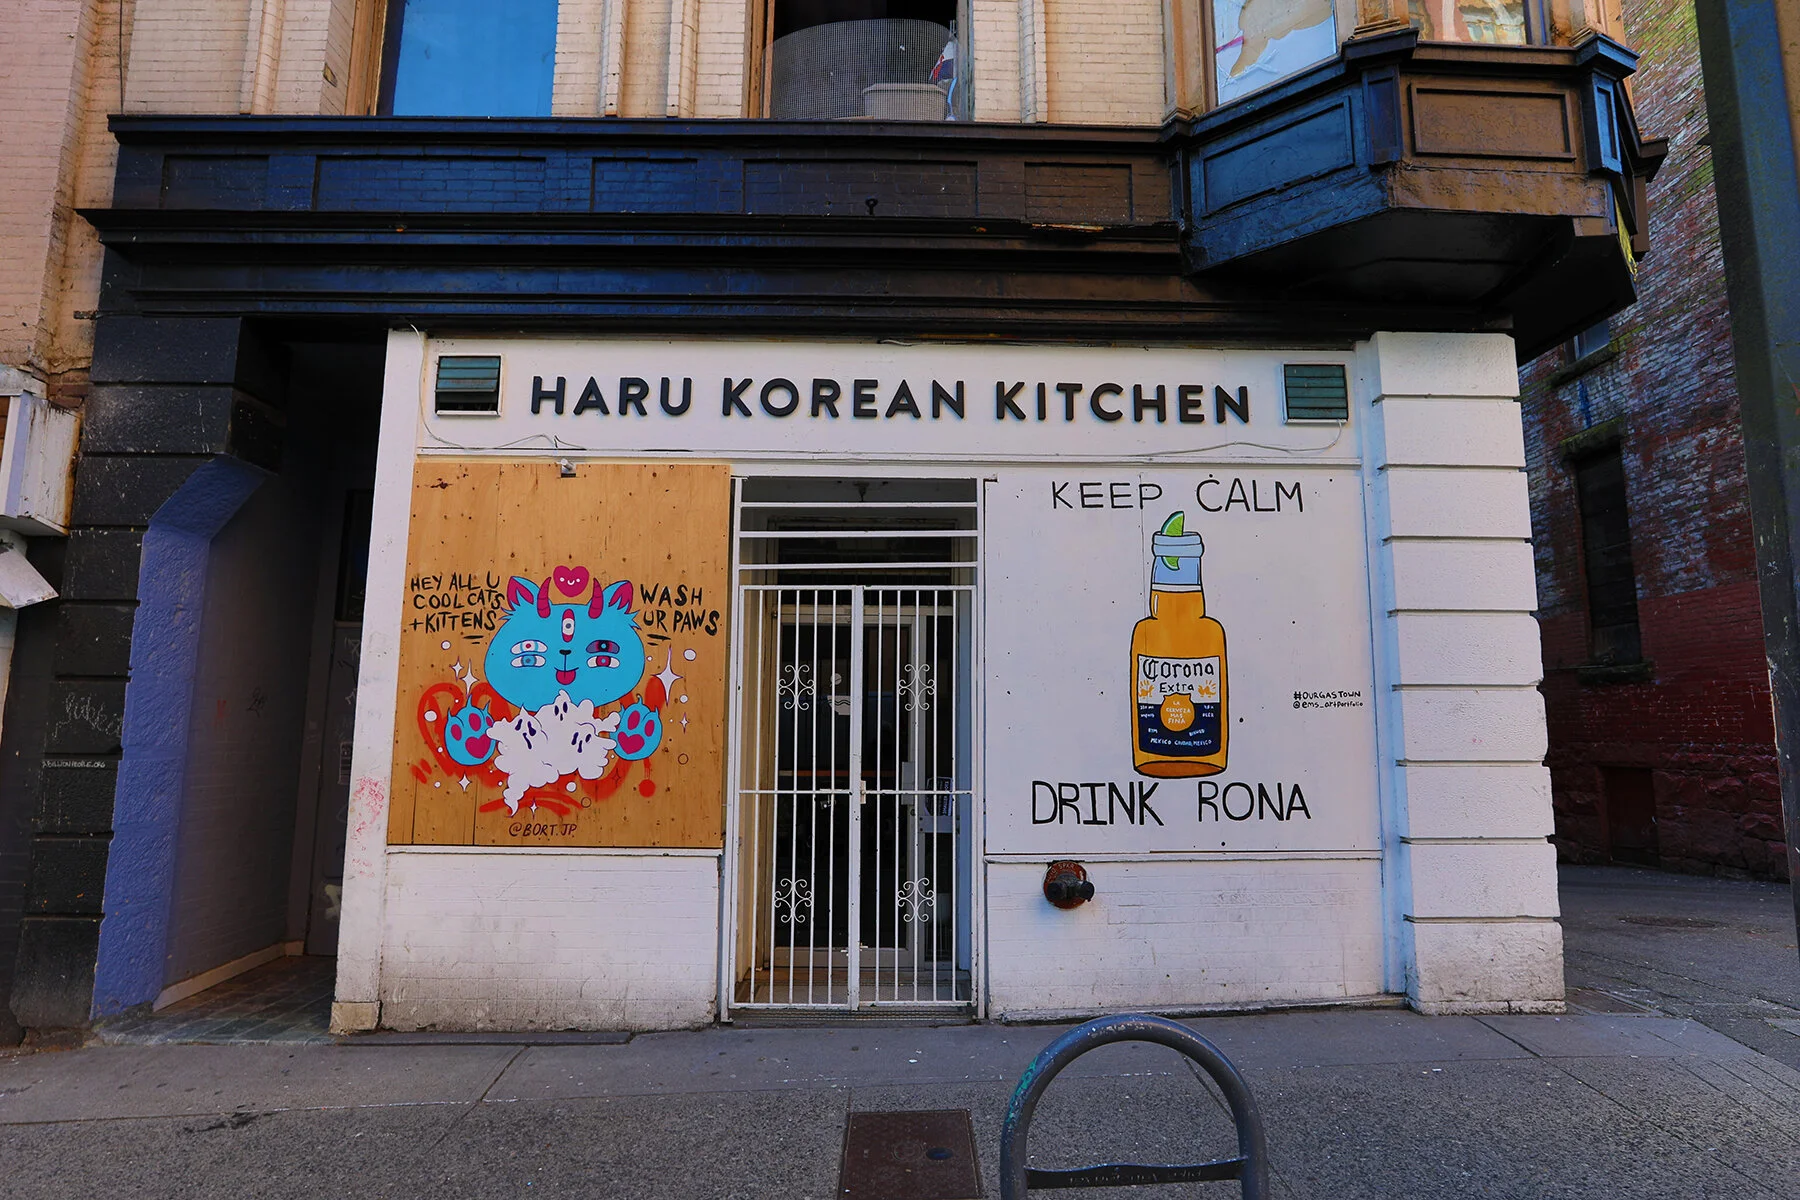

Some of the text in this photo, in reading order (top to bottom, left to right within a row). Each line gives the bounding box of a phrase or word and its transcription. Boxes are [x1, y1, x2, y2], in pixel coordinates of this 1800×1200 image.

[530, 376, 1250, 424] HARU KOREAN KITCHEN
[1051, 478, 1304, 513] KEEP CALM
[410, 570, 500, 592] HEY ALL U
[413, 589, 505, 610] COOL CATS
[640, 582, 703, 609] WASH
[643, 608, 720, 636] UR PAWS
[1143, 659, 1214, 682] Corona
[1159, 682, 1195, 693] Extra
[1031, 780, 1312, 826] DRINK RONA
[508, 822, 578, 837] @BORT.JP
